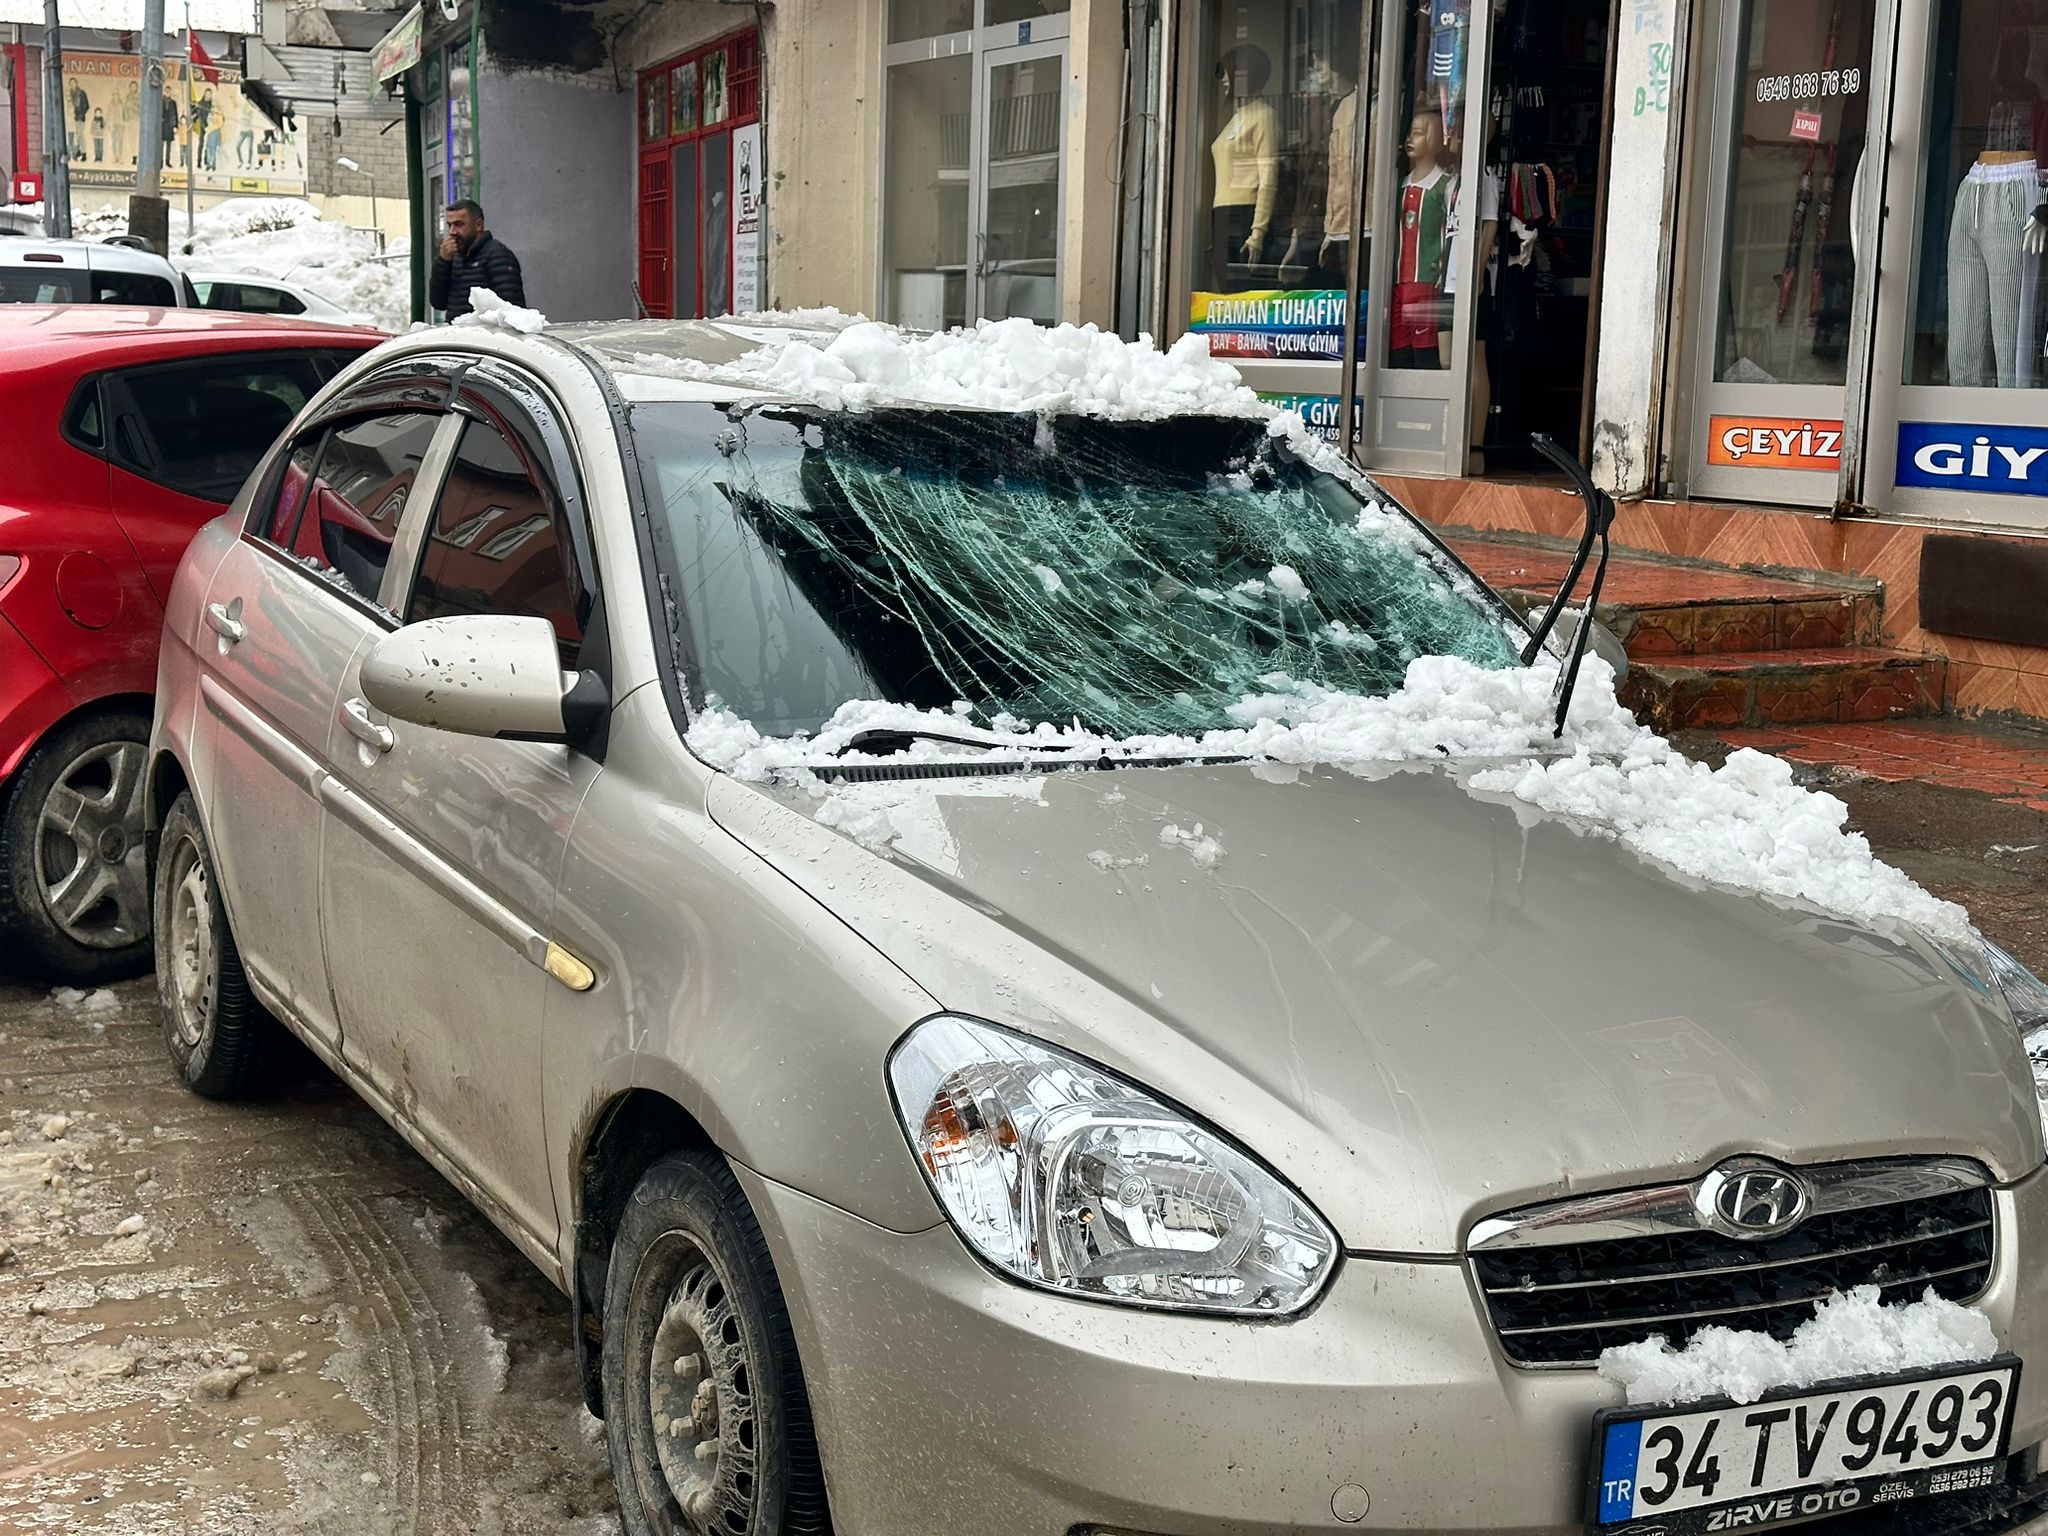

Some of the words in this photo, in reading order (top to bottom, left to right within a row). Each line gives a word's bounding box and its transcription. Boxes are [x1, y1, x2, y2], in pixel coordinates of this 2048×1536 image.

[1756, 76, 1790, 102] 0546
[1792, 73, 1819, 99] 868
[1821, 70, 1840, 96] 76
[1841, 68, 1860, 94] 39
[1795, 118, 1818, 132] KAPALI
[1206, 299, 1268, 325] ATAMAN
[1272, 292, 1347, 326] TUHAFİY
[1213, 334, 1230, 350] BAY
[1237, 334, 1268, 351] BAYAN
[1275, 333, 1308, 356] ÇOCUK
[1309, 330, 1339, 353] GİYİM
[1325, 427, 1340, 441] 459
[1722, 424, 1842, 460] ÇEYİZ
[1639, 1418, 1720, 1505] 34
[1745, 1400, 1840, 1487] TV
[1841, 1379, 1999, 1471] 9493
[1604, 1479, 1632, 1503] TR
[1880, 1481, 1910, 1493] ÖZEL
[1969, 1477, 1980, 1488] 27
[1981, 1476, 1991, 1486] 24
[1801, 1487, 1861, 1514] OTO
